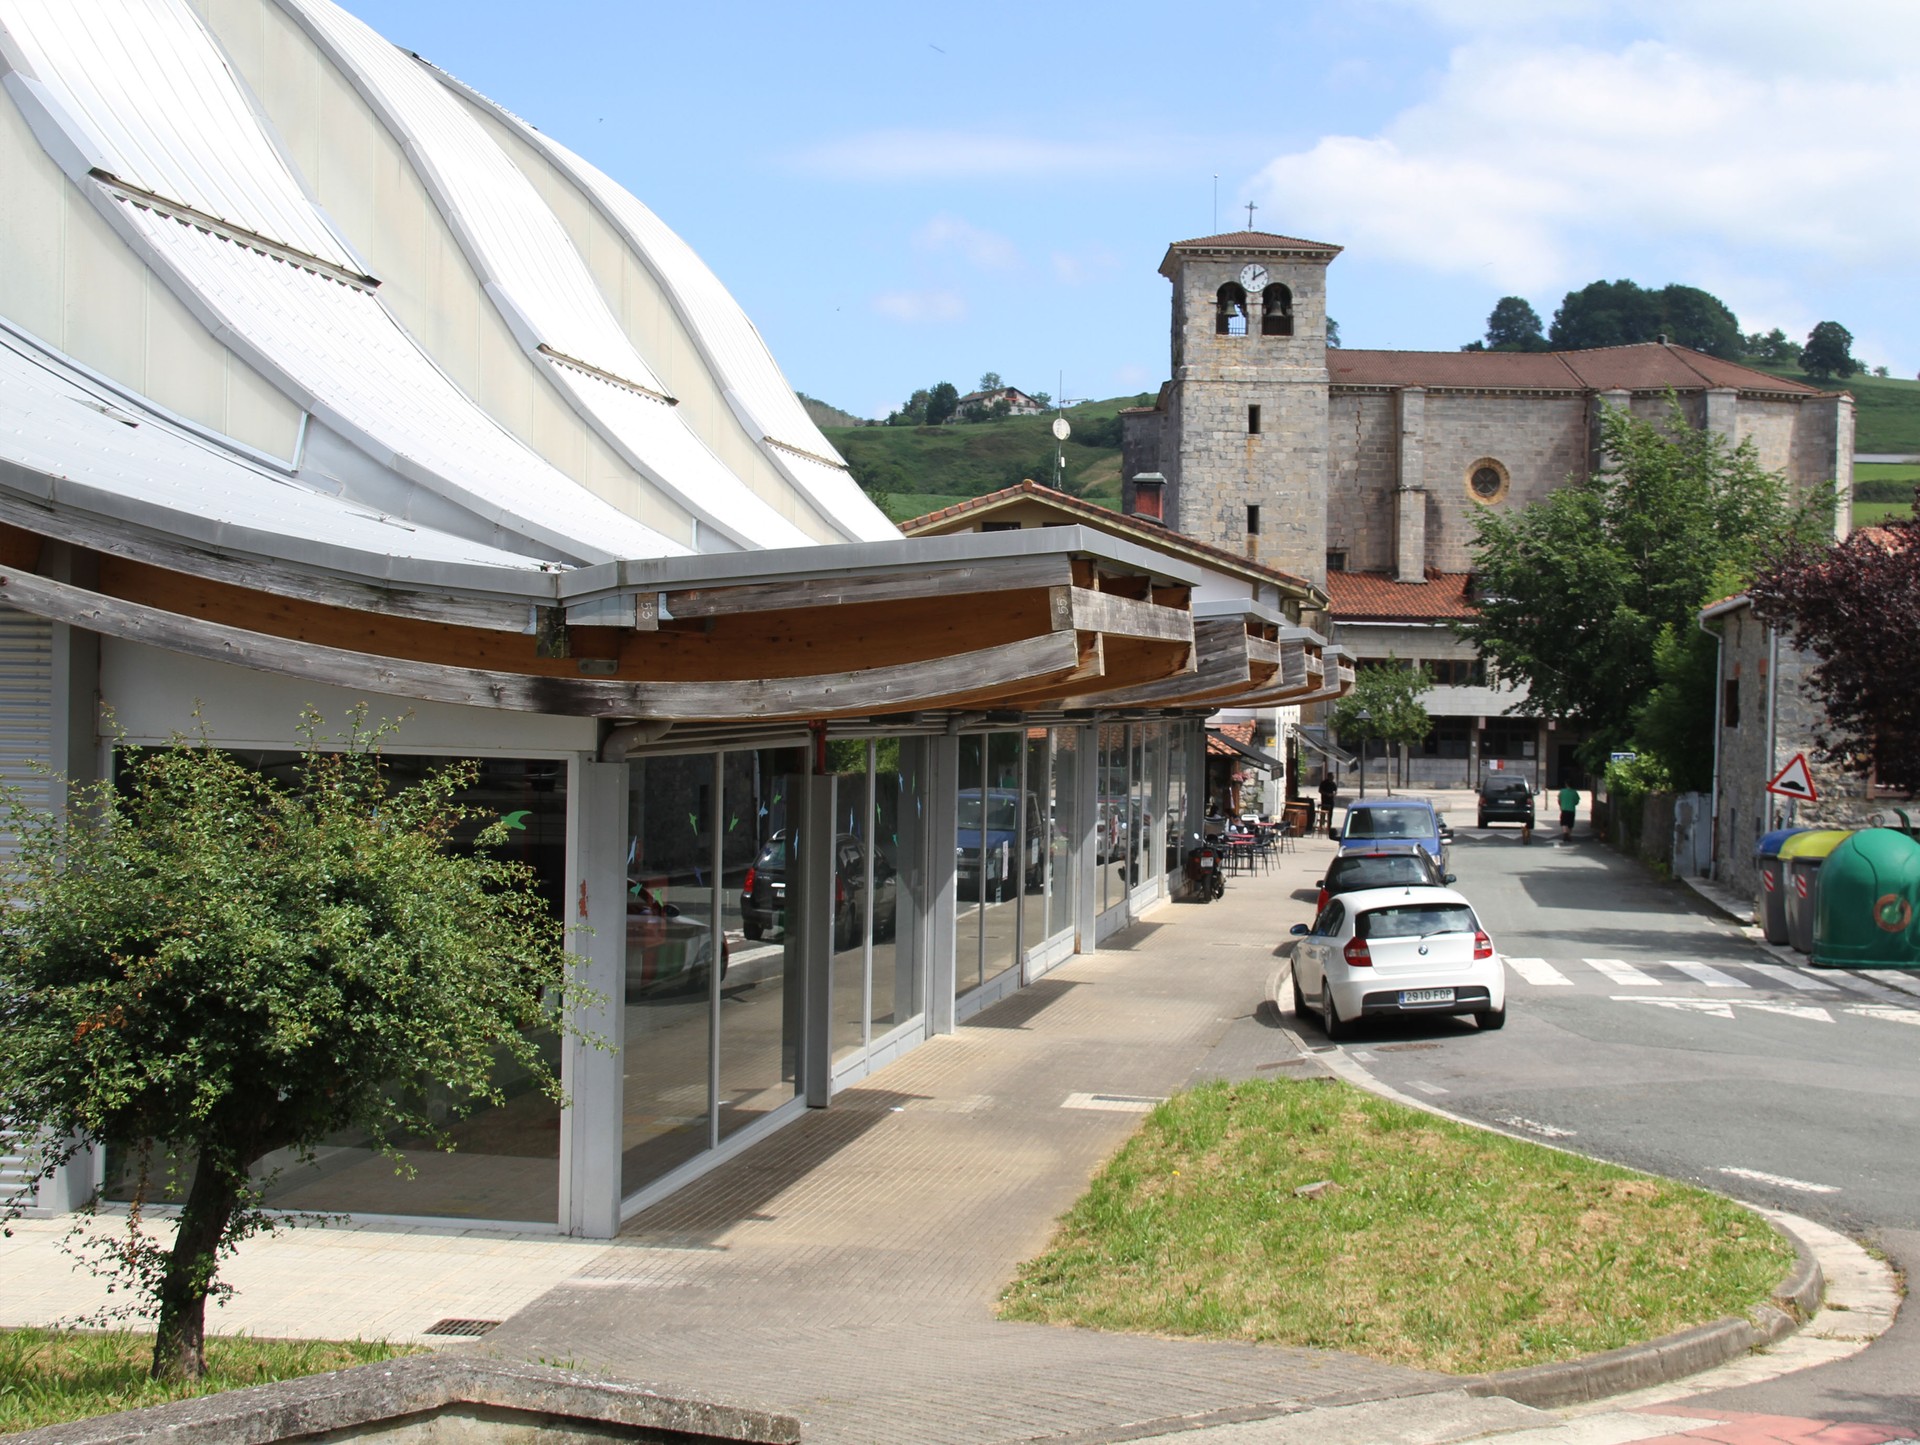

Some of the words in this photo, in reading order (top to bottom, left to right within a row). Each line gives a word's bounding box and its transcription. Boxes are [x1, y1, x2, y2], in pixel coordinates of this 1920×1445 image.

[640, 602, 653, 620] 53
[1056, 598, 1069, 615] 55
[1406, 991, 1431, 1002] 2910
